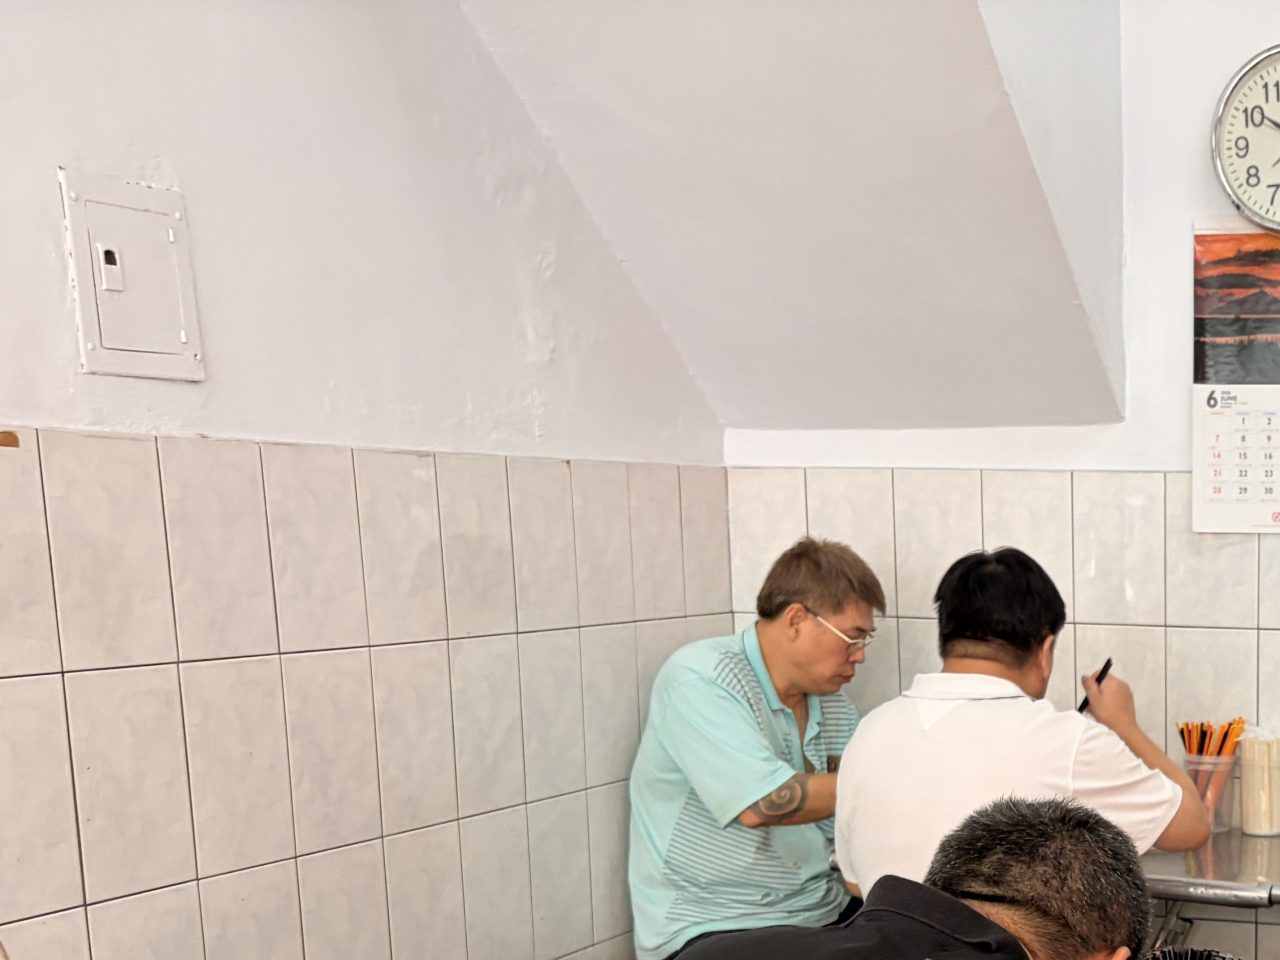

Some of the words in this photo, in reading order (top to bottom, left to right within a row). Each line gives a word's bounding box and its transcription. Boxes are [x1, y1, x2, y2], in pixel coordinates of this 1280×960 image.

[1262, 80, 1280, 103] 11
[1242, 105, 1265, 128] 10
[1235, 136, 1249, 158] 9
[1246, 165, 1260, 187] 8
[1266, 184, 1280, 206] 7
[1206, 390, 1218, 409] 6
